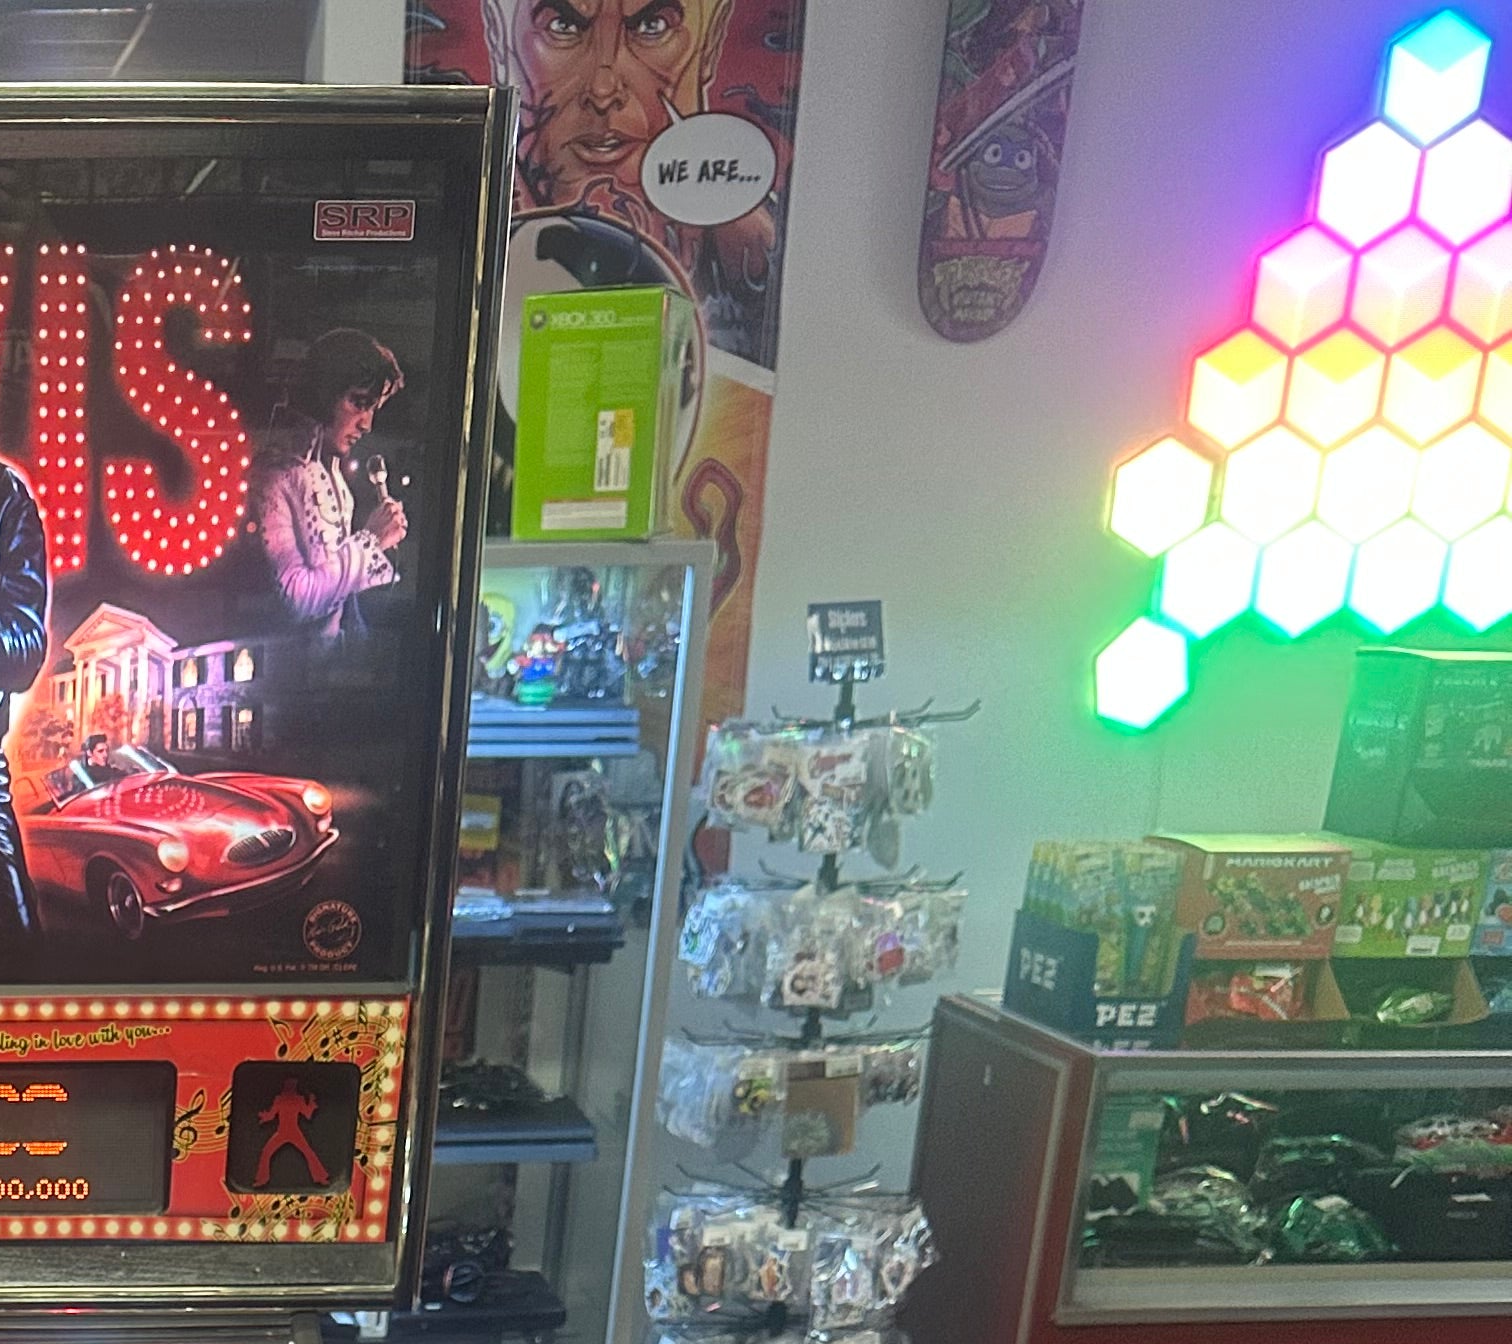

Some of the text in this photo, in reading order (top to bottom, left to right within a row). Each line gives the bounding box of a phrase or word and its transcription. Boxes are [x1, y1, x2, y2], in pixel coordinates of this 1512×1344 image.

[658, 159, 761, 185] WE ARE...
[320, 204, 410, 229] SRP
[308, 903, 357, 922] SIGNATURE
[309, 940, 354, 957] PRODUCT
[1019, 948, 1058, 990] PEZ
[1095, 1002, 1157, 1027] PEZ
[35, 1034, 49, 1049] in
[53, 1029, 85, 1052] love
[89, 1023, 121, 1046] with
